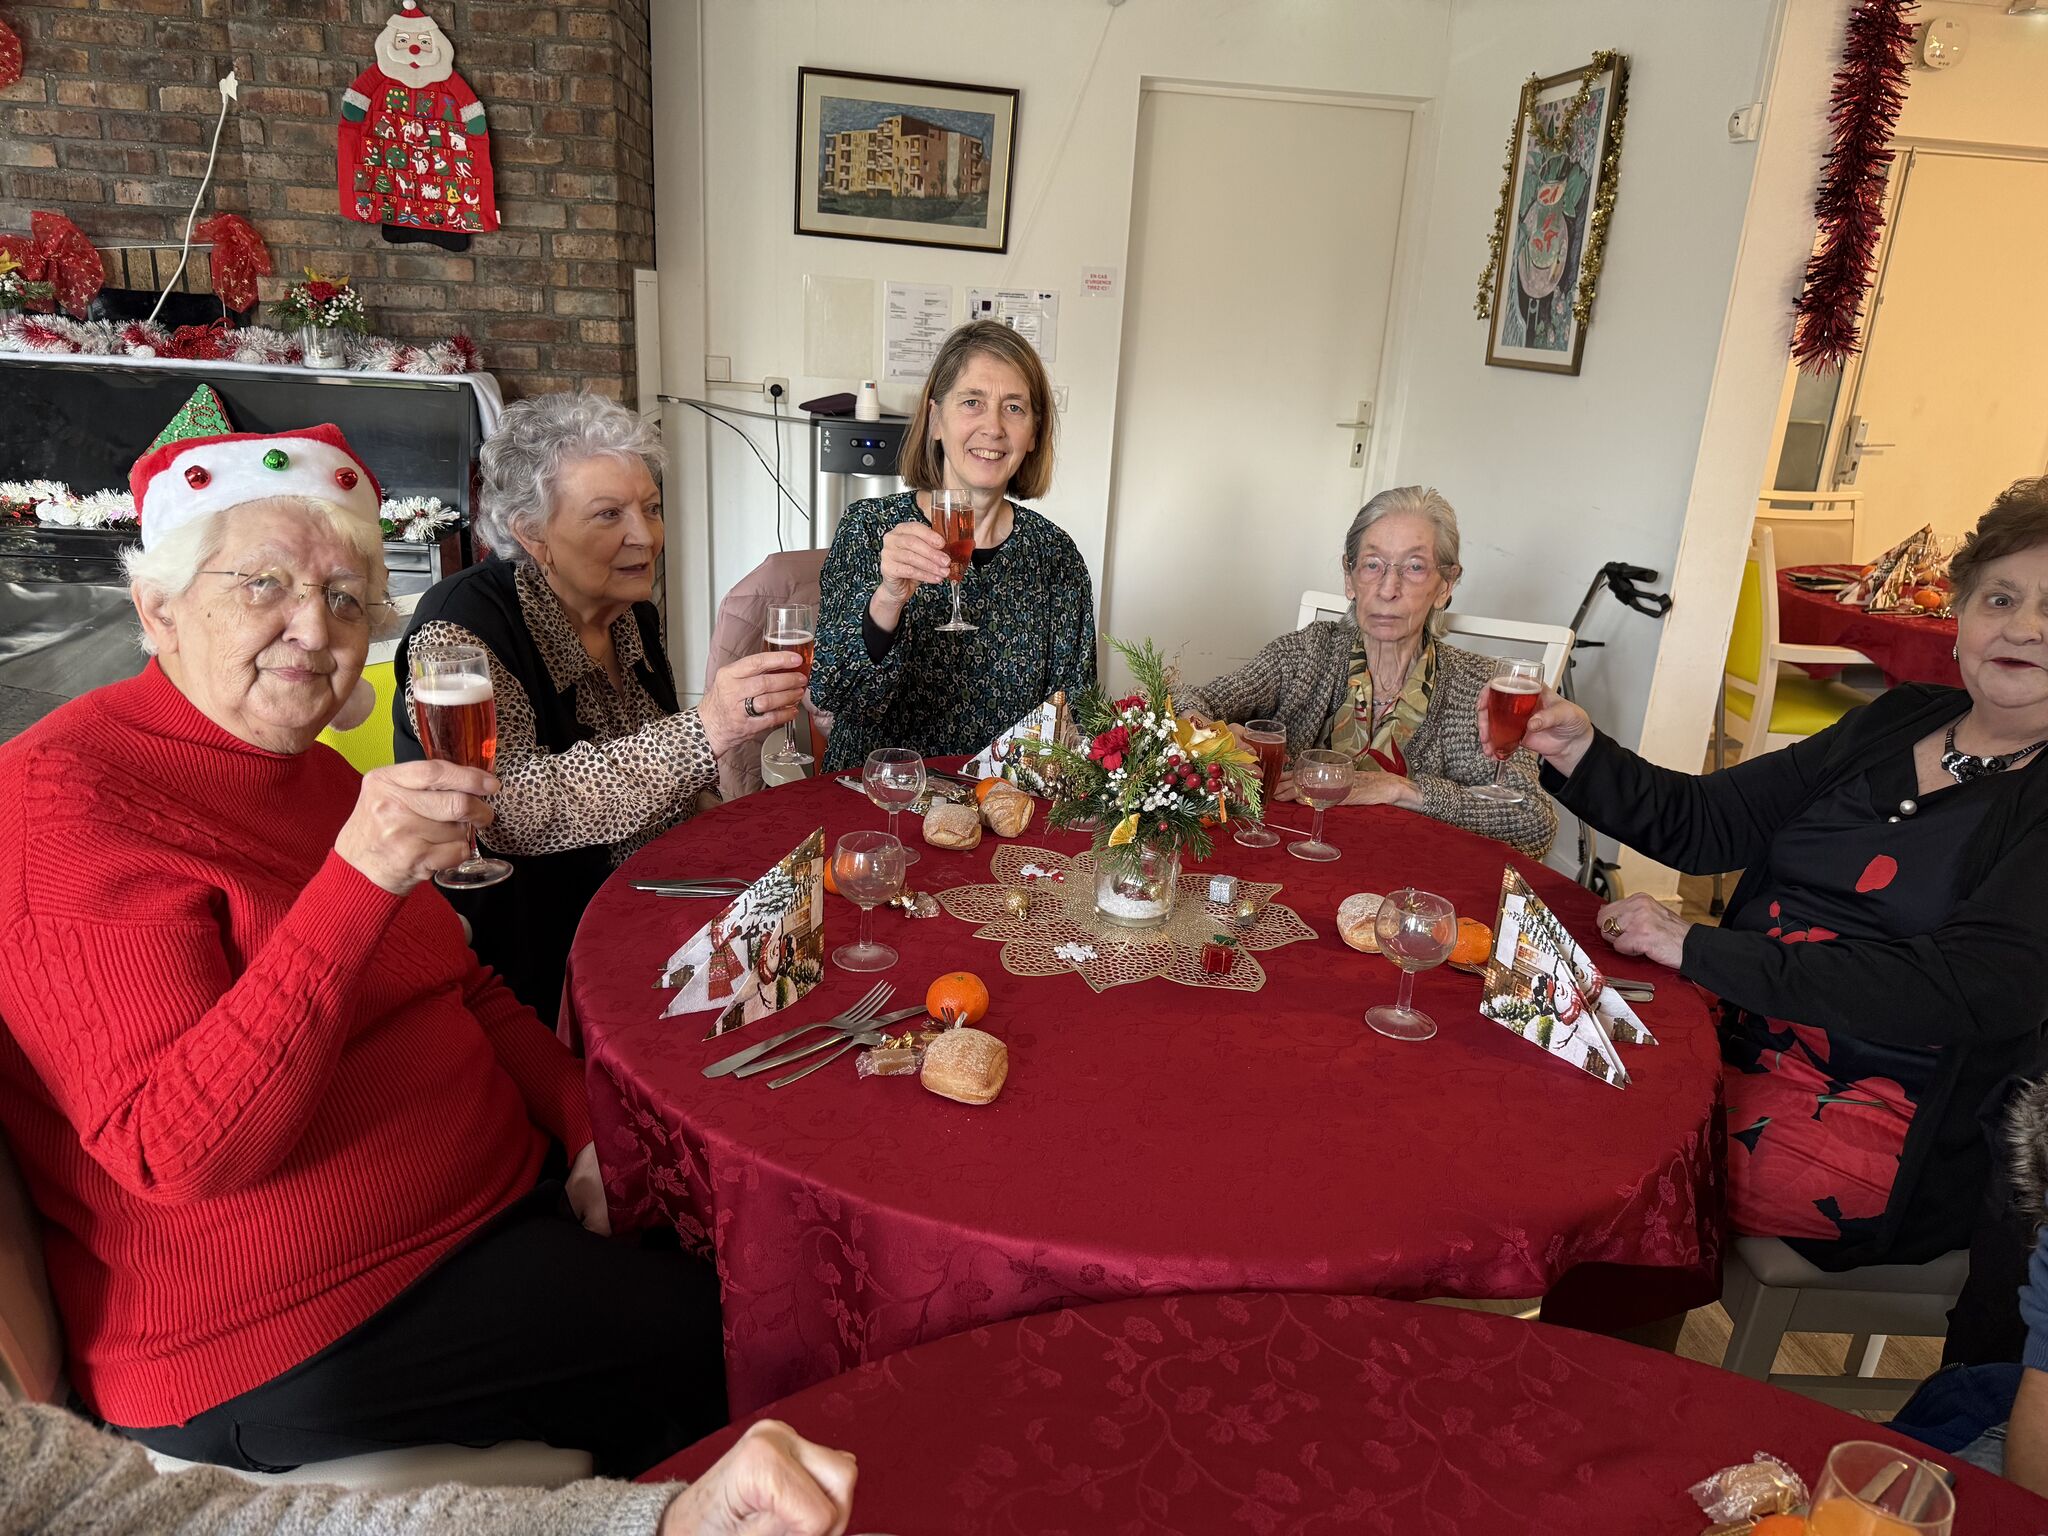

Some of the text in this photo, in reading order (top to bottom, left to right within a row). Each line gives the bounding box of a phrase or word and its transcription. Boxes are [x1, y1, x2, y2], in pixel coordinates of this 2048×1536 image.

[440, 121, 446, 129] 6
[365, 165, 373, 173] 13
[434, 202, 442, 210] 22
[473, 204, 480, 212] 24
